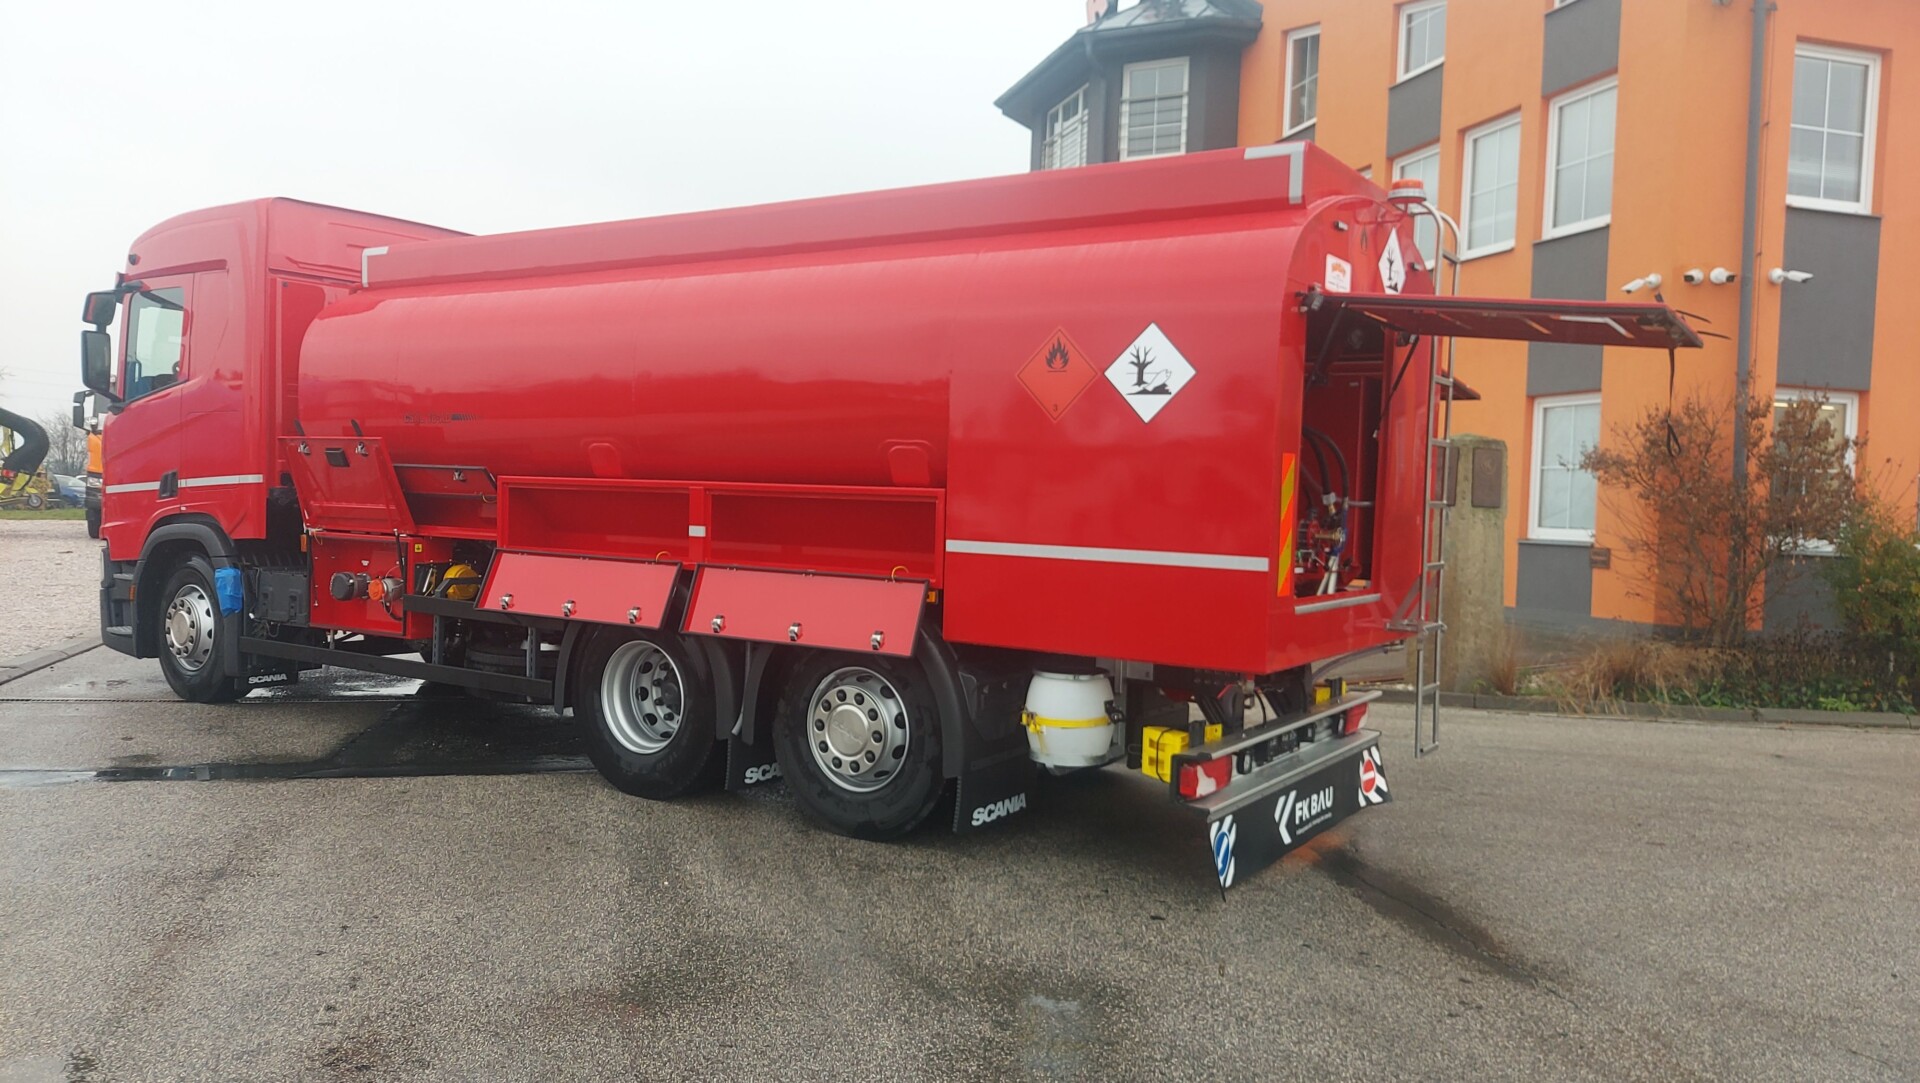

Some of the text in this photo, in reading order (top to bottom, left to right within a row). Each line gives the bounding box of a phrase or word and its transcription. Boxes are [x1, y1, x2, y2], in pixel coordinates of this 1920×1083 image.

[248, 673, 288, 684] SCANIA
[744, 762, 782, 784] SCA
[971, 792, 1026, 827] SCANIA
[1295, 797, 1310, 826] FK
[1310, 785, 1334, 816] BAU
